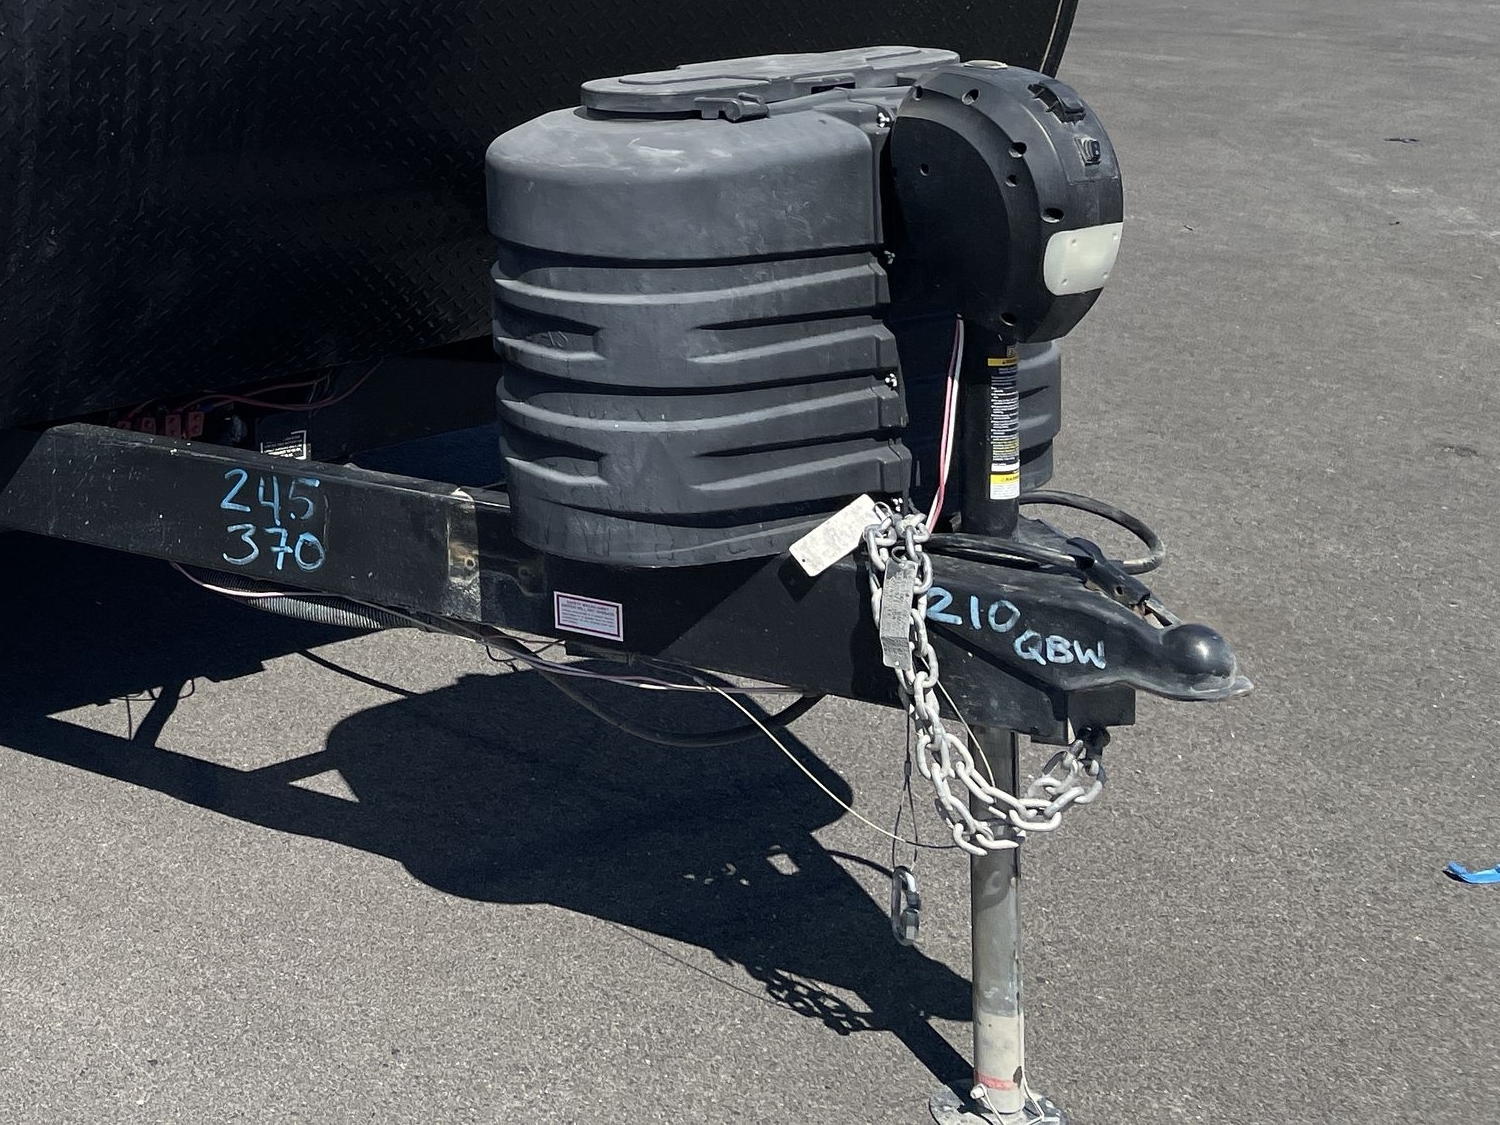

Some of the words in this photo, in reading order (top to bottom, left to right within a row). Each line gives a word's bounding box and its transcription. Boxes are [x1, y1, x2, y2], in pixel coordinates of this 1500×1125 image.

[223, 523, 325, 572] 370
[926, 586, 1021, 633] 210
[1013, 629, 1106, 670] QBW
